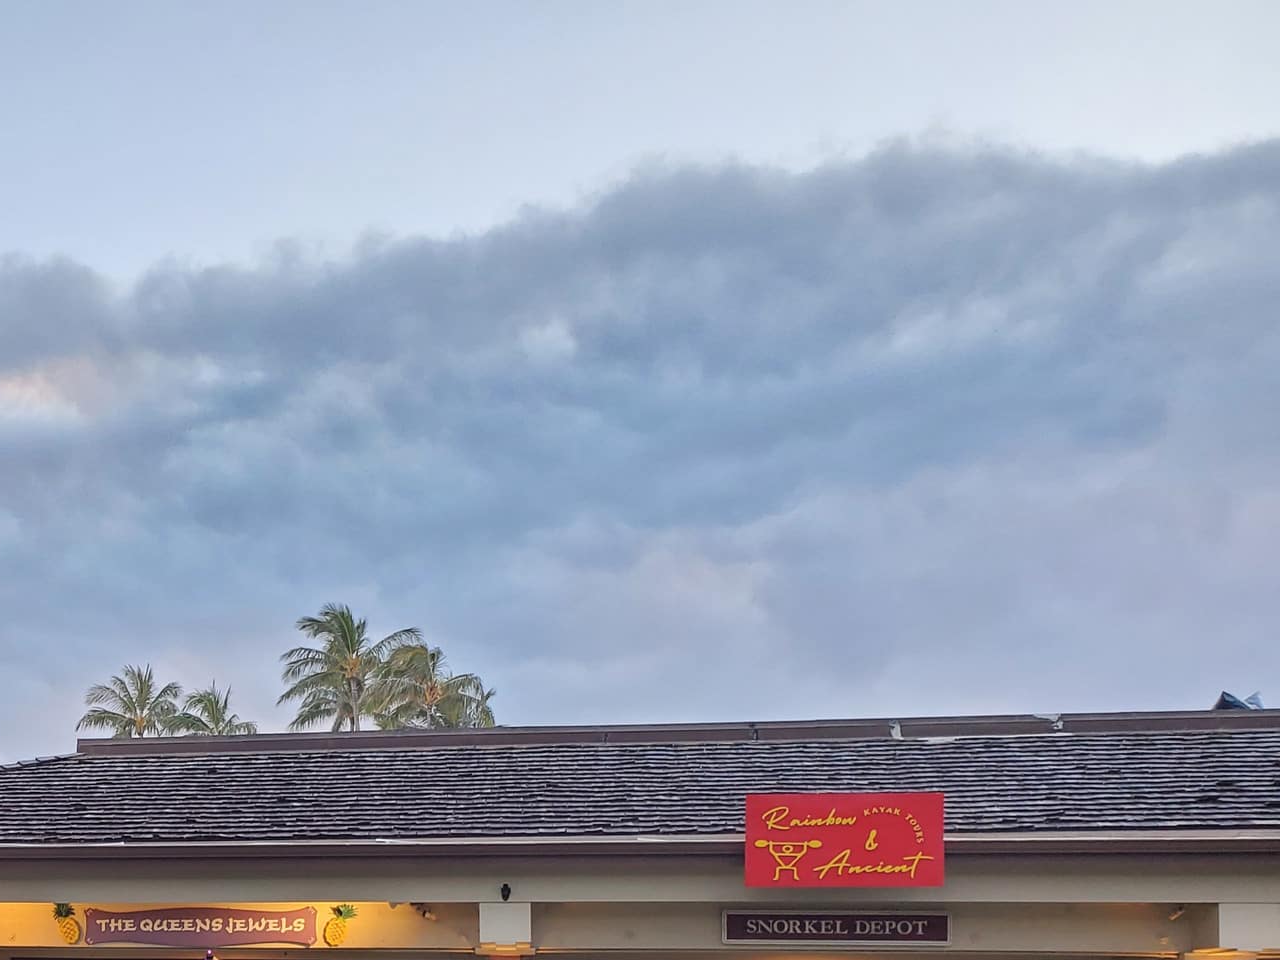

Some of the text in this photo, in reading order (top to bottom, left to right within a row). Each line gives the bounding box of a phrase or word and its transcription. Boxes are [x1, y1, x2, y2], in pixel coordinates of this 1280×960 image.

[762, 806, 857, 831] Rainbow
[863, 806, 925, 844] KAYAK TOURS
[865, 829, 879, 851] &
[813, 849, 935, 880] Ancient
[96, 917, 305, 934] THE QUEENS JEWELS
[746, 919, 928, 935] SNORKEL DEPOT
